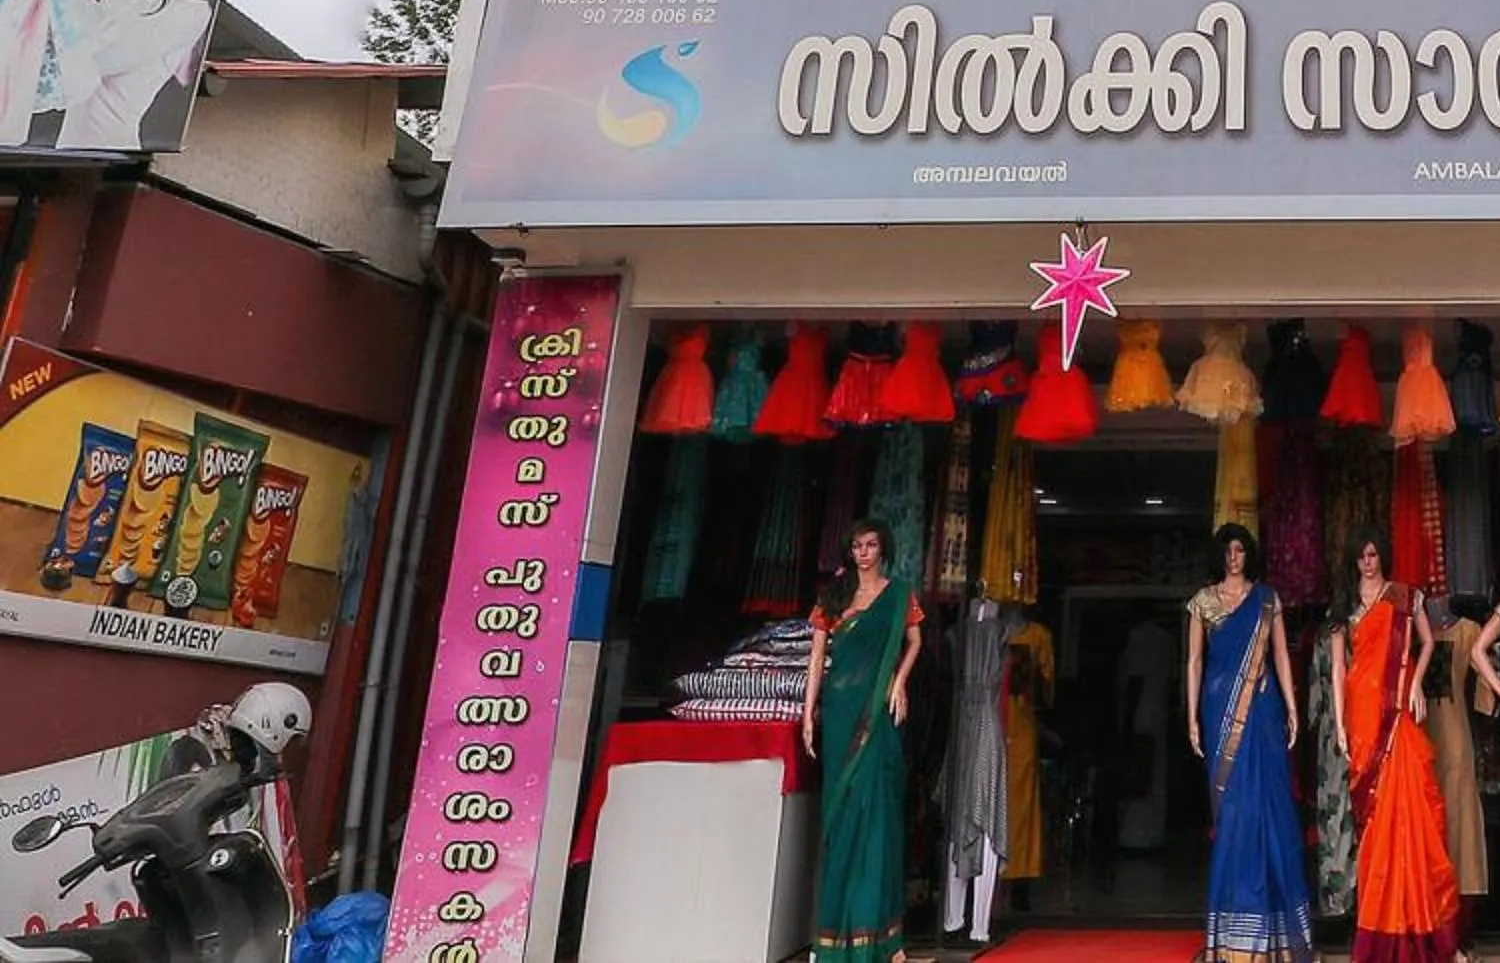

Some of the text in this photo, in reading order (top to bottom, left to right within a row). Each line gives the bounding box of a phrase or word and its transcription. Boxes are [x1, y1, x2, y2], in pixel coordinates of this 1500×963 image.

[583, 7, 717, 25] 90 728 006 62
[778, 2, 1249, 137] സിൽക്കി
[9, 362, 53, 401] NEW
[89, 609, 223, 653] INDIAN BAKERY
